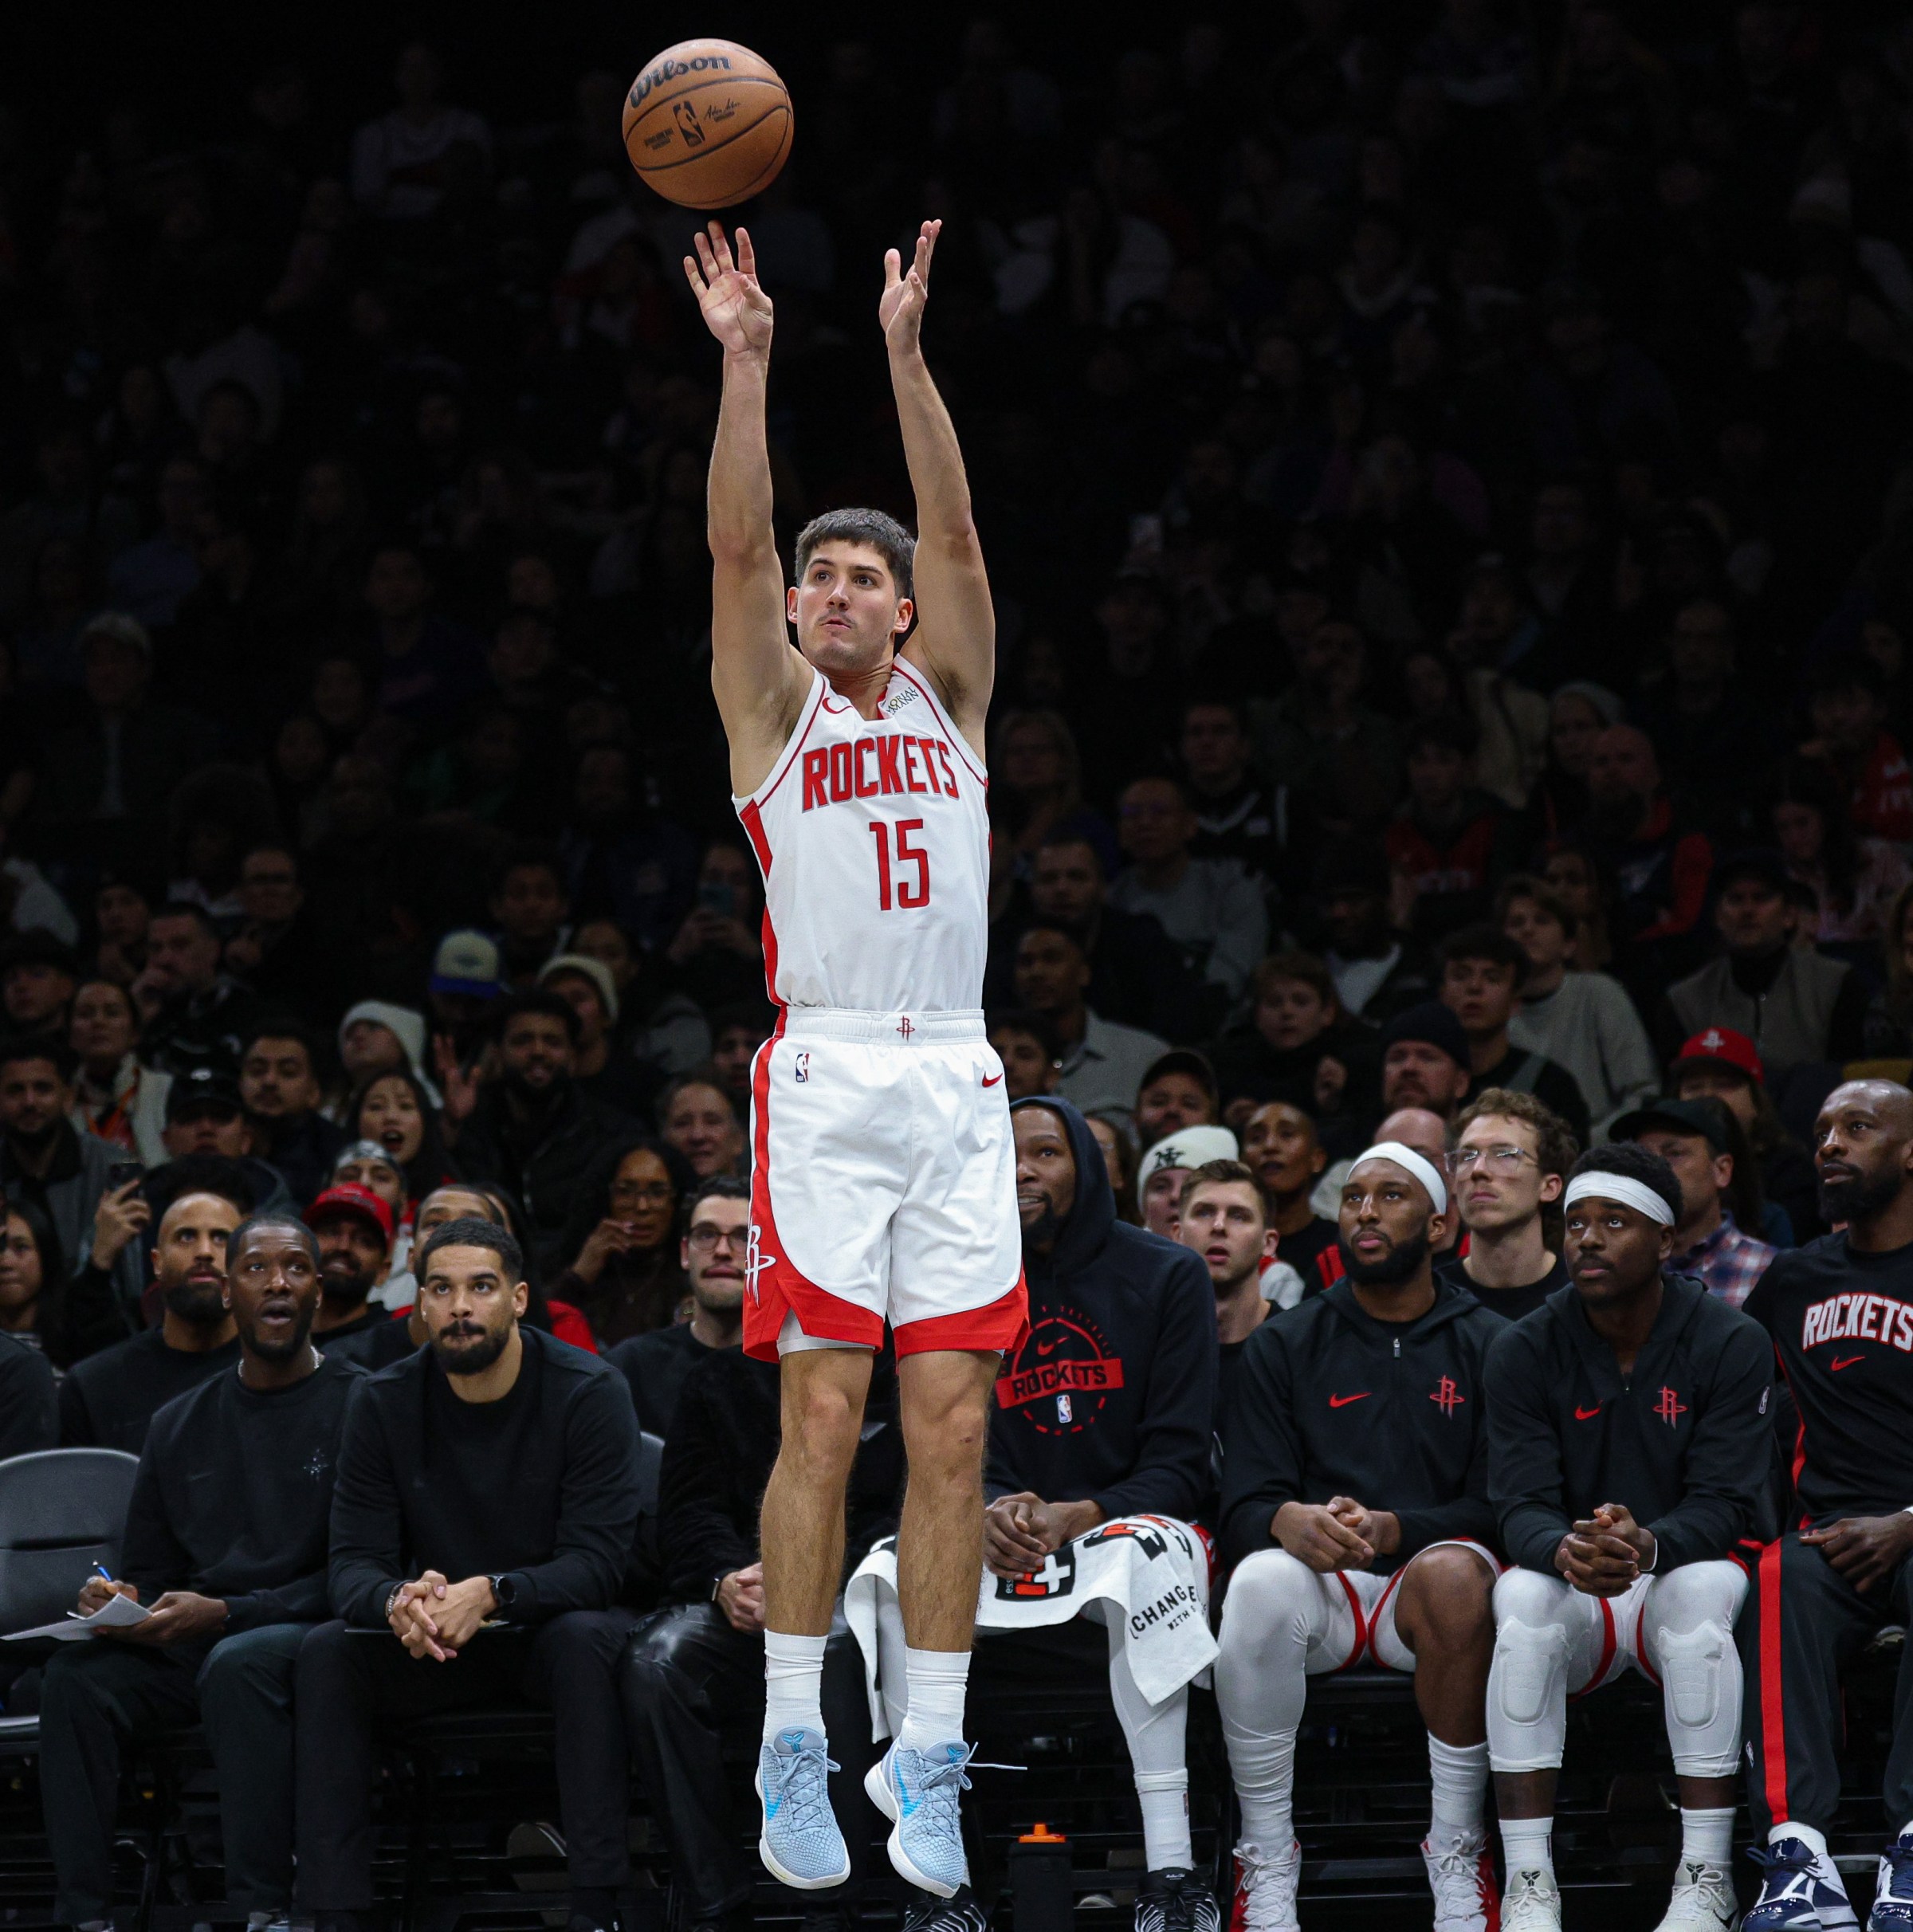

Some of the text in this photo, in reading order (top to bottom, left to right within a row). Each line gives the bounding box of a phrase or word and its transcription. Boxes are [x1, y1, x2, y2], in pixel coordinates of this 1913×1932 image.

[630, 57, 732, 108] Wilson
[893, 691, 919, 715] MANN
[802, 732, 960, 813] ROCKETS
[869, 819, 929, 911] 15
[1802, 1292, 1913, 1353] ROCKETS
[1131, 1585, 1196, 1632] CHANGE
[1167, 1610, 1190, 1631] WITH
